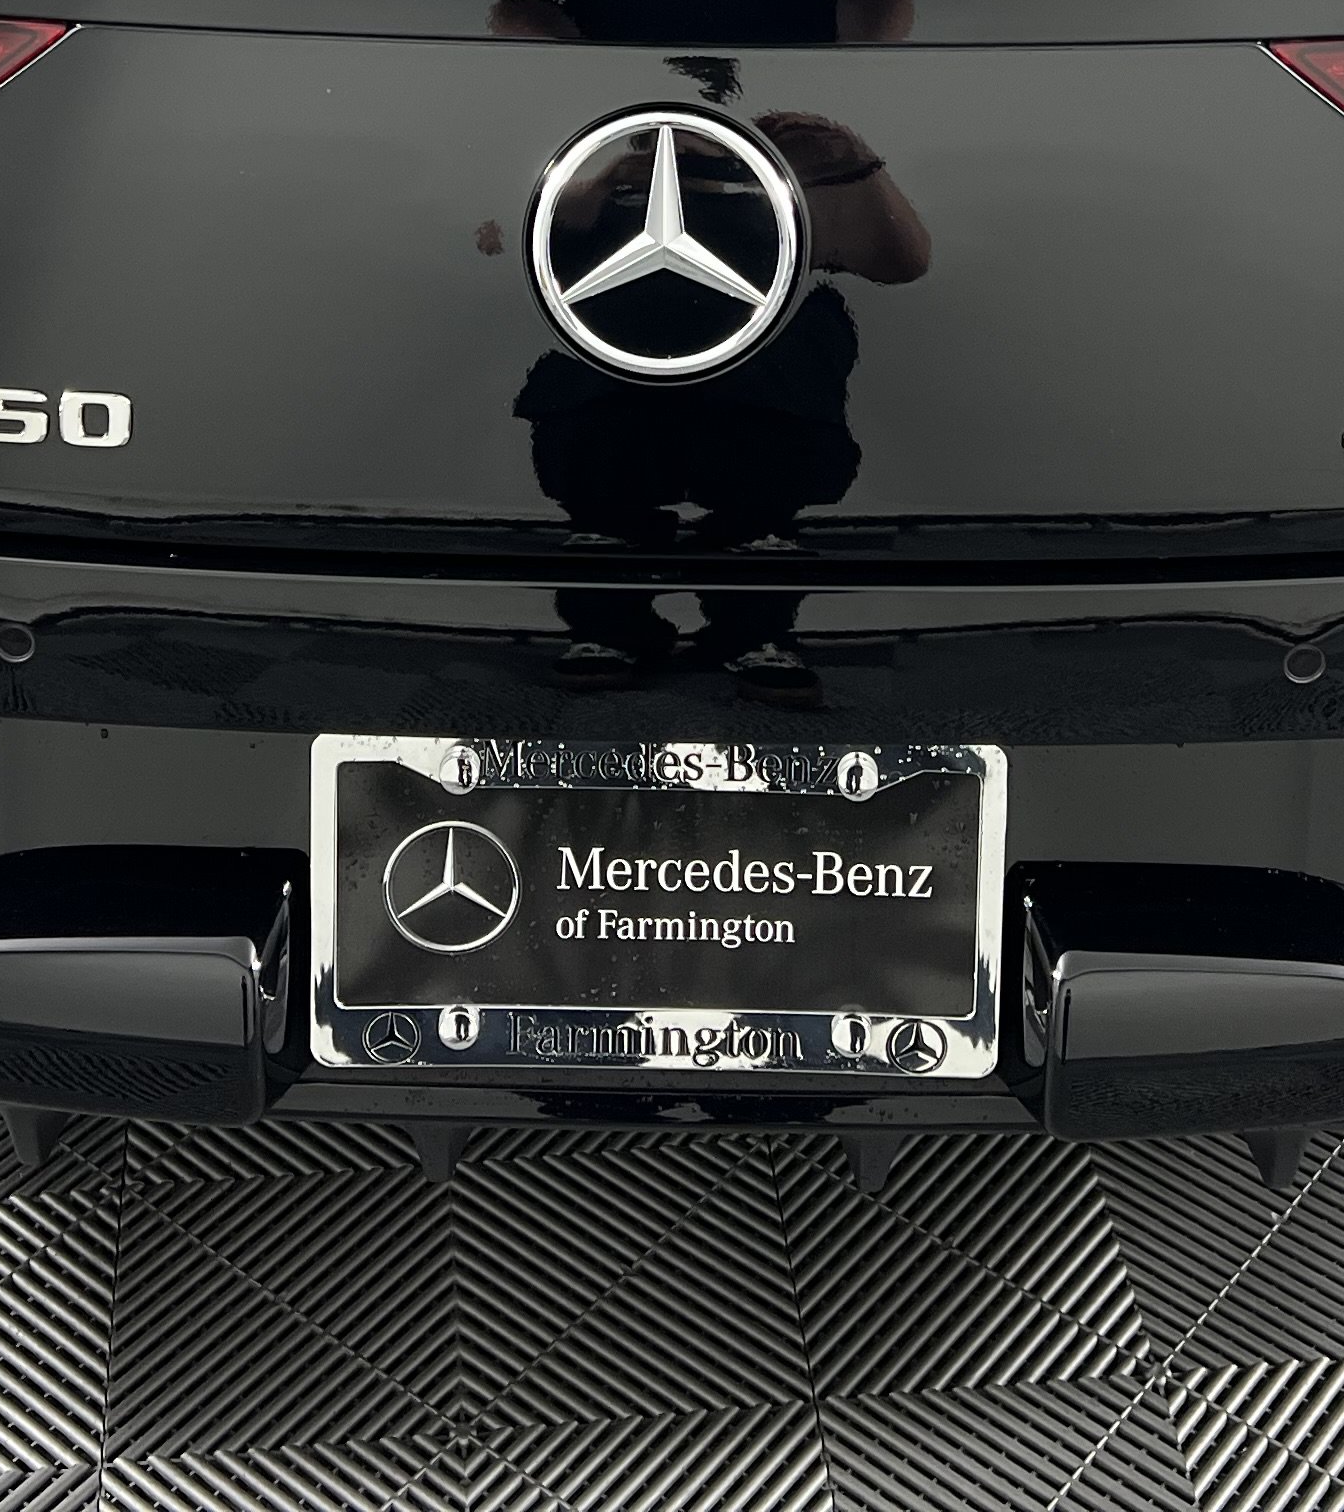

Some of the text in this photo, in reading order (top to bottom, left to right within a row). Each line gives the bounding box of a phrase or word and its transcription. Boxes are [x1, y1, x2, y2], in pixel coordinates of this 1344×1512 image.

[480, 739, 840, 786] Mercedes-Benz
[556, 846, 934, 898] Mercedes-Benz
[556, 909, 796, 949] of Farmington
[506, 1011, 805, 1066] Farmington
